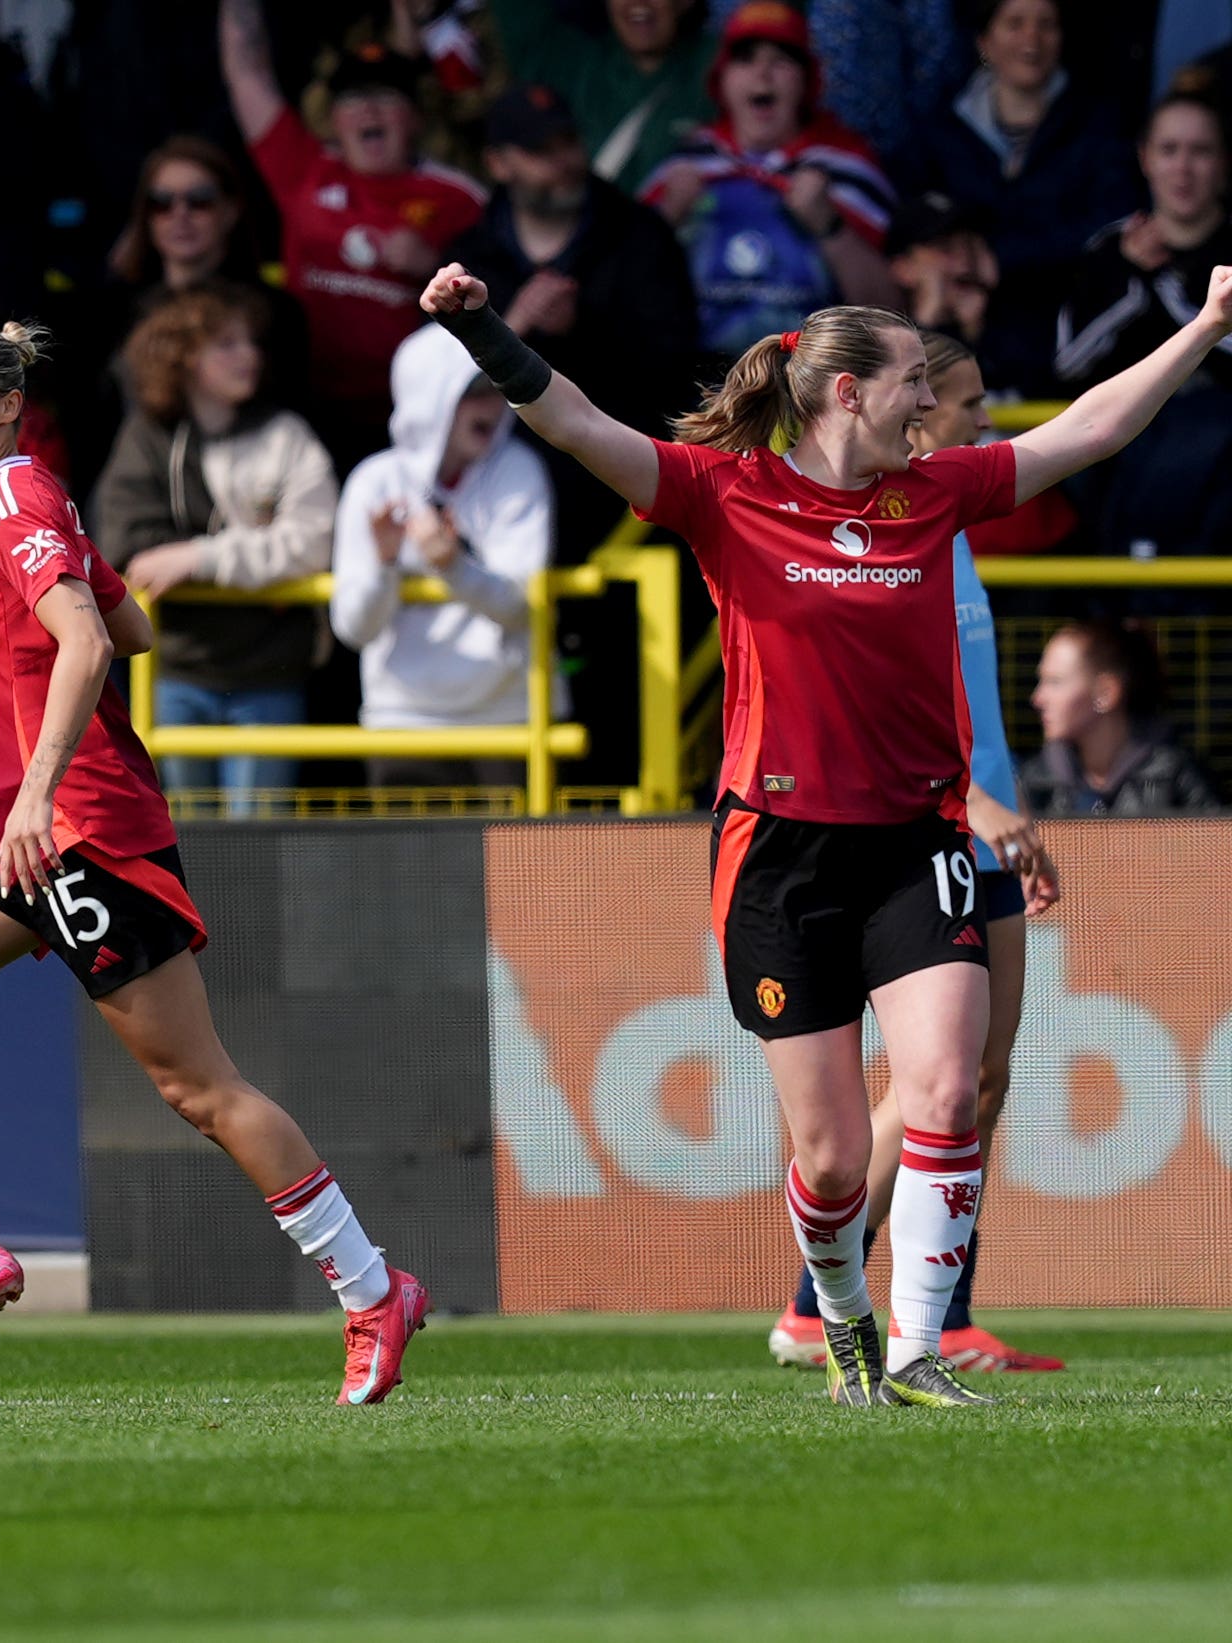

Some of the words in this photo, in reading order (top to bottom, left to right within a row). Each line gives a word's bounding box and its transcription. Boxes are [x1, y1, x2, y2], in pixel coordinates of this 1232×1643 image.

[784, 562, 922, 588] Snapdragon
[48, 868, 111, 950] 15
[930, 850, 975, 918] 19
